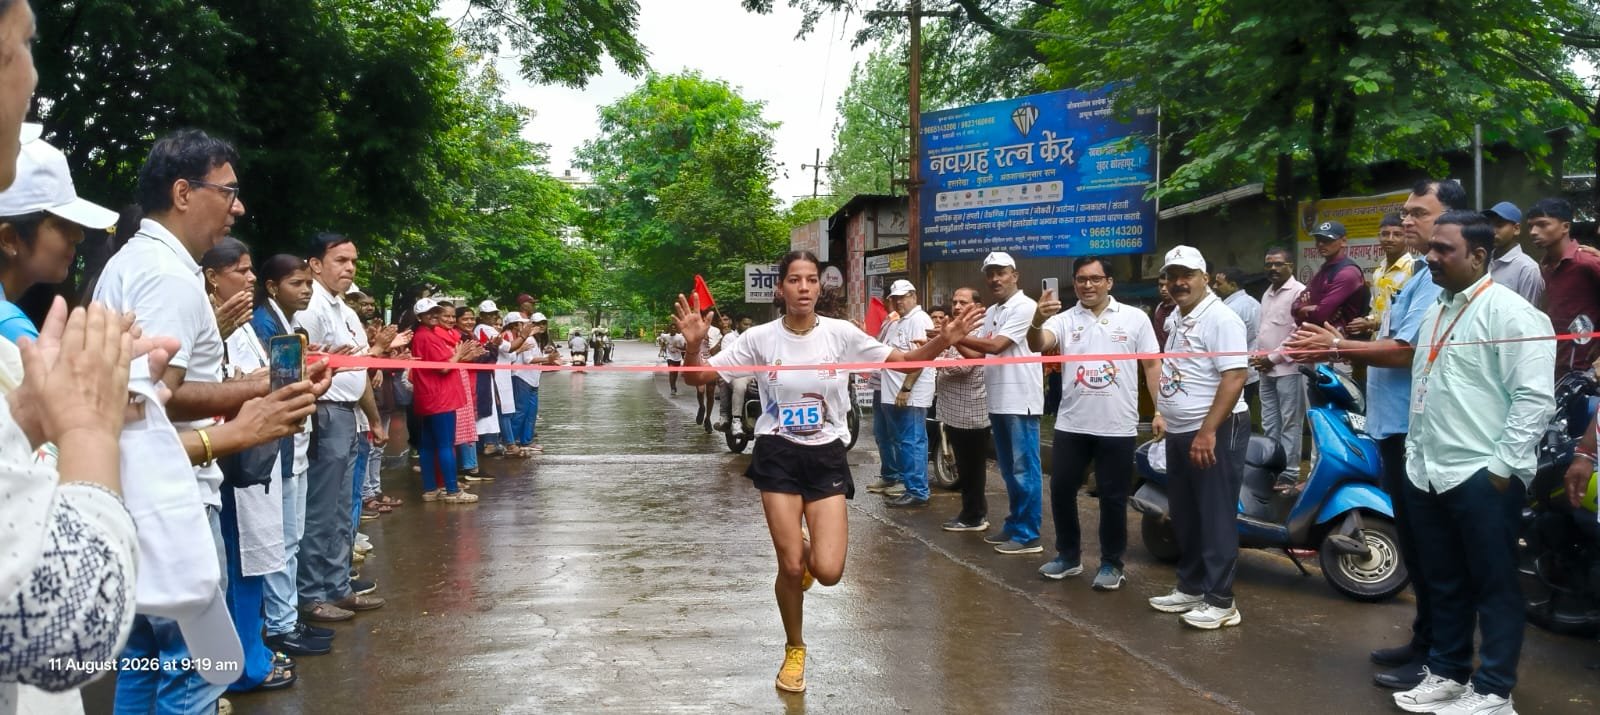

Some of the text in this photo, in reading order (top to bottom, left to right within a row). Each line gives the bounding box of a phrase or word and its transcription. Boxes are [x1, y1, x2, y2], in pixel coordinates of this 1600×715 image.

[929, 149, 990, 175] नवग्रह
[994, 143, 1035, 168] रत्न
[1039, 130, 1075, 165] केंद्र
[1090, 225, 1143, 237] 9665143200
[1090, 237, 1143, 249] 9823160666
[782, 407, 819, 426] 215
